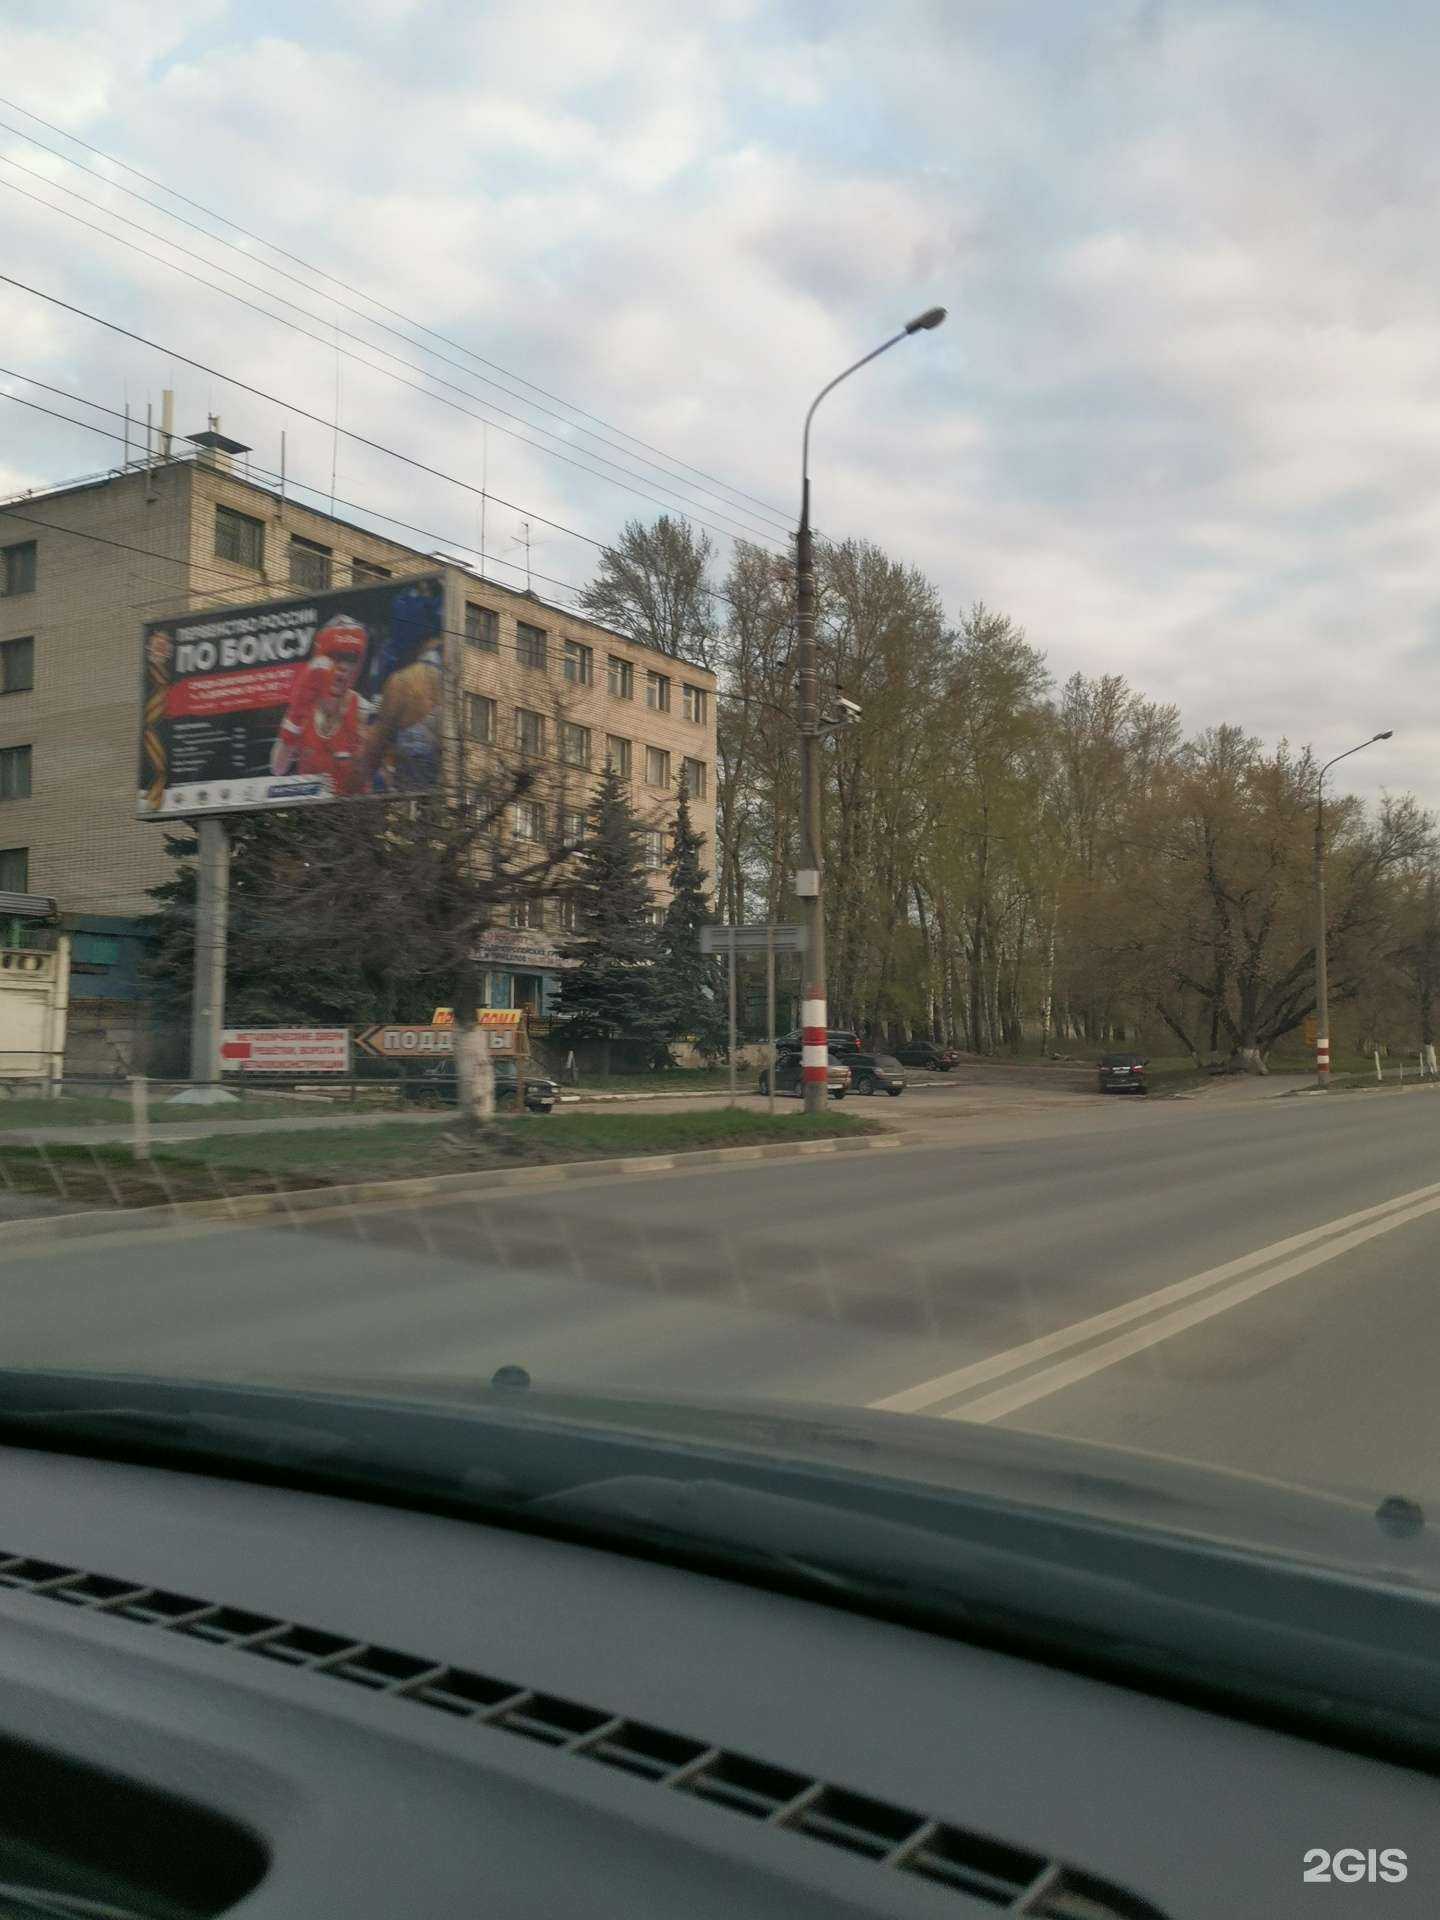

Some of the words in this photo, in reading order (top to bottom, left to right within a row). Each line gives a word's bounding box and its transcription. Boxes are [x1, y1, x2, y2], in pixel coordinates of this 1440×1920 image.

[176, 641, 217, 673] ПО
[219, 627, 317, 667] БОКСУ
[384, 1030, 512, 1049] ПОДДЫ
